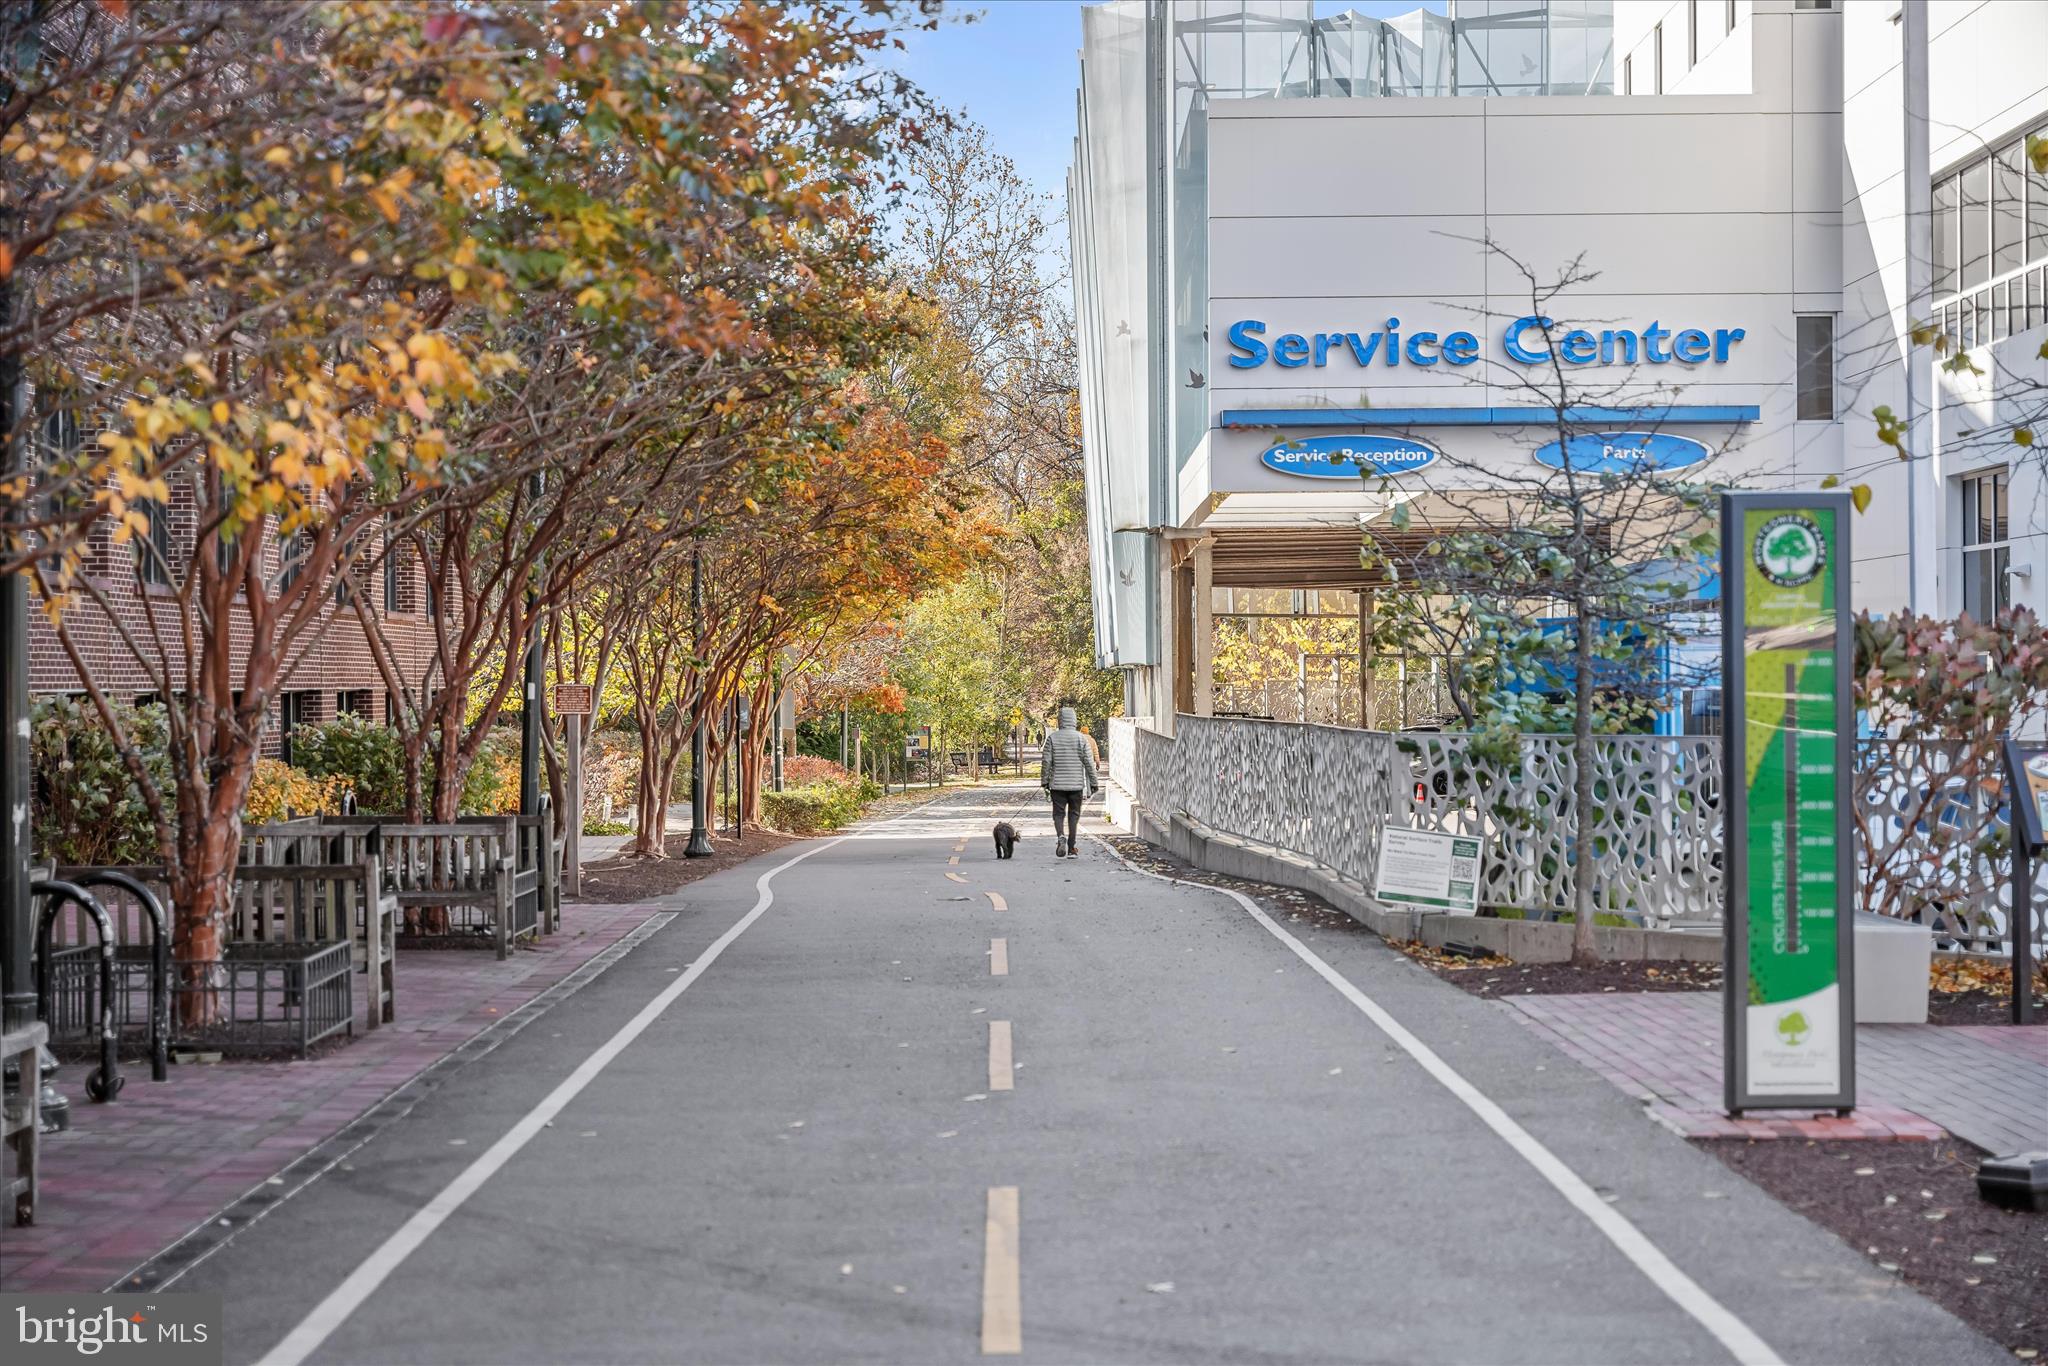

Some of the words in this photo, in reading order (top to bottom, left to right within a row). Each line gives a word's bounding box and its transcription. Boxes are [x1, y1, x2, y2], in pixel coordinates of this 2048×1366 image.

[1228, 317, 1479, 368] Service
[1504, 315, 1746, 364] Center
[1274, 449, 1338, 463] Servic
[1342, 448, 1427, 465] Reception
[1603, 445, 1646, 459] Parts
[1772, 820, 1785, 857] YEAR
[1772, 860, 1785, 890] THIS
[1772, 893, 1785, 954] CYCLISTS
